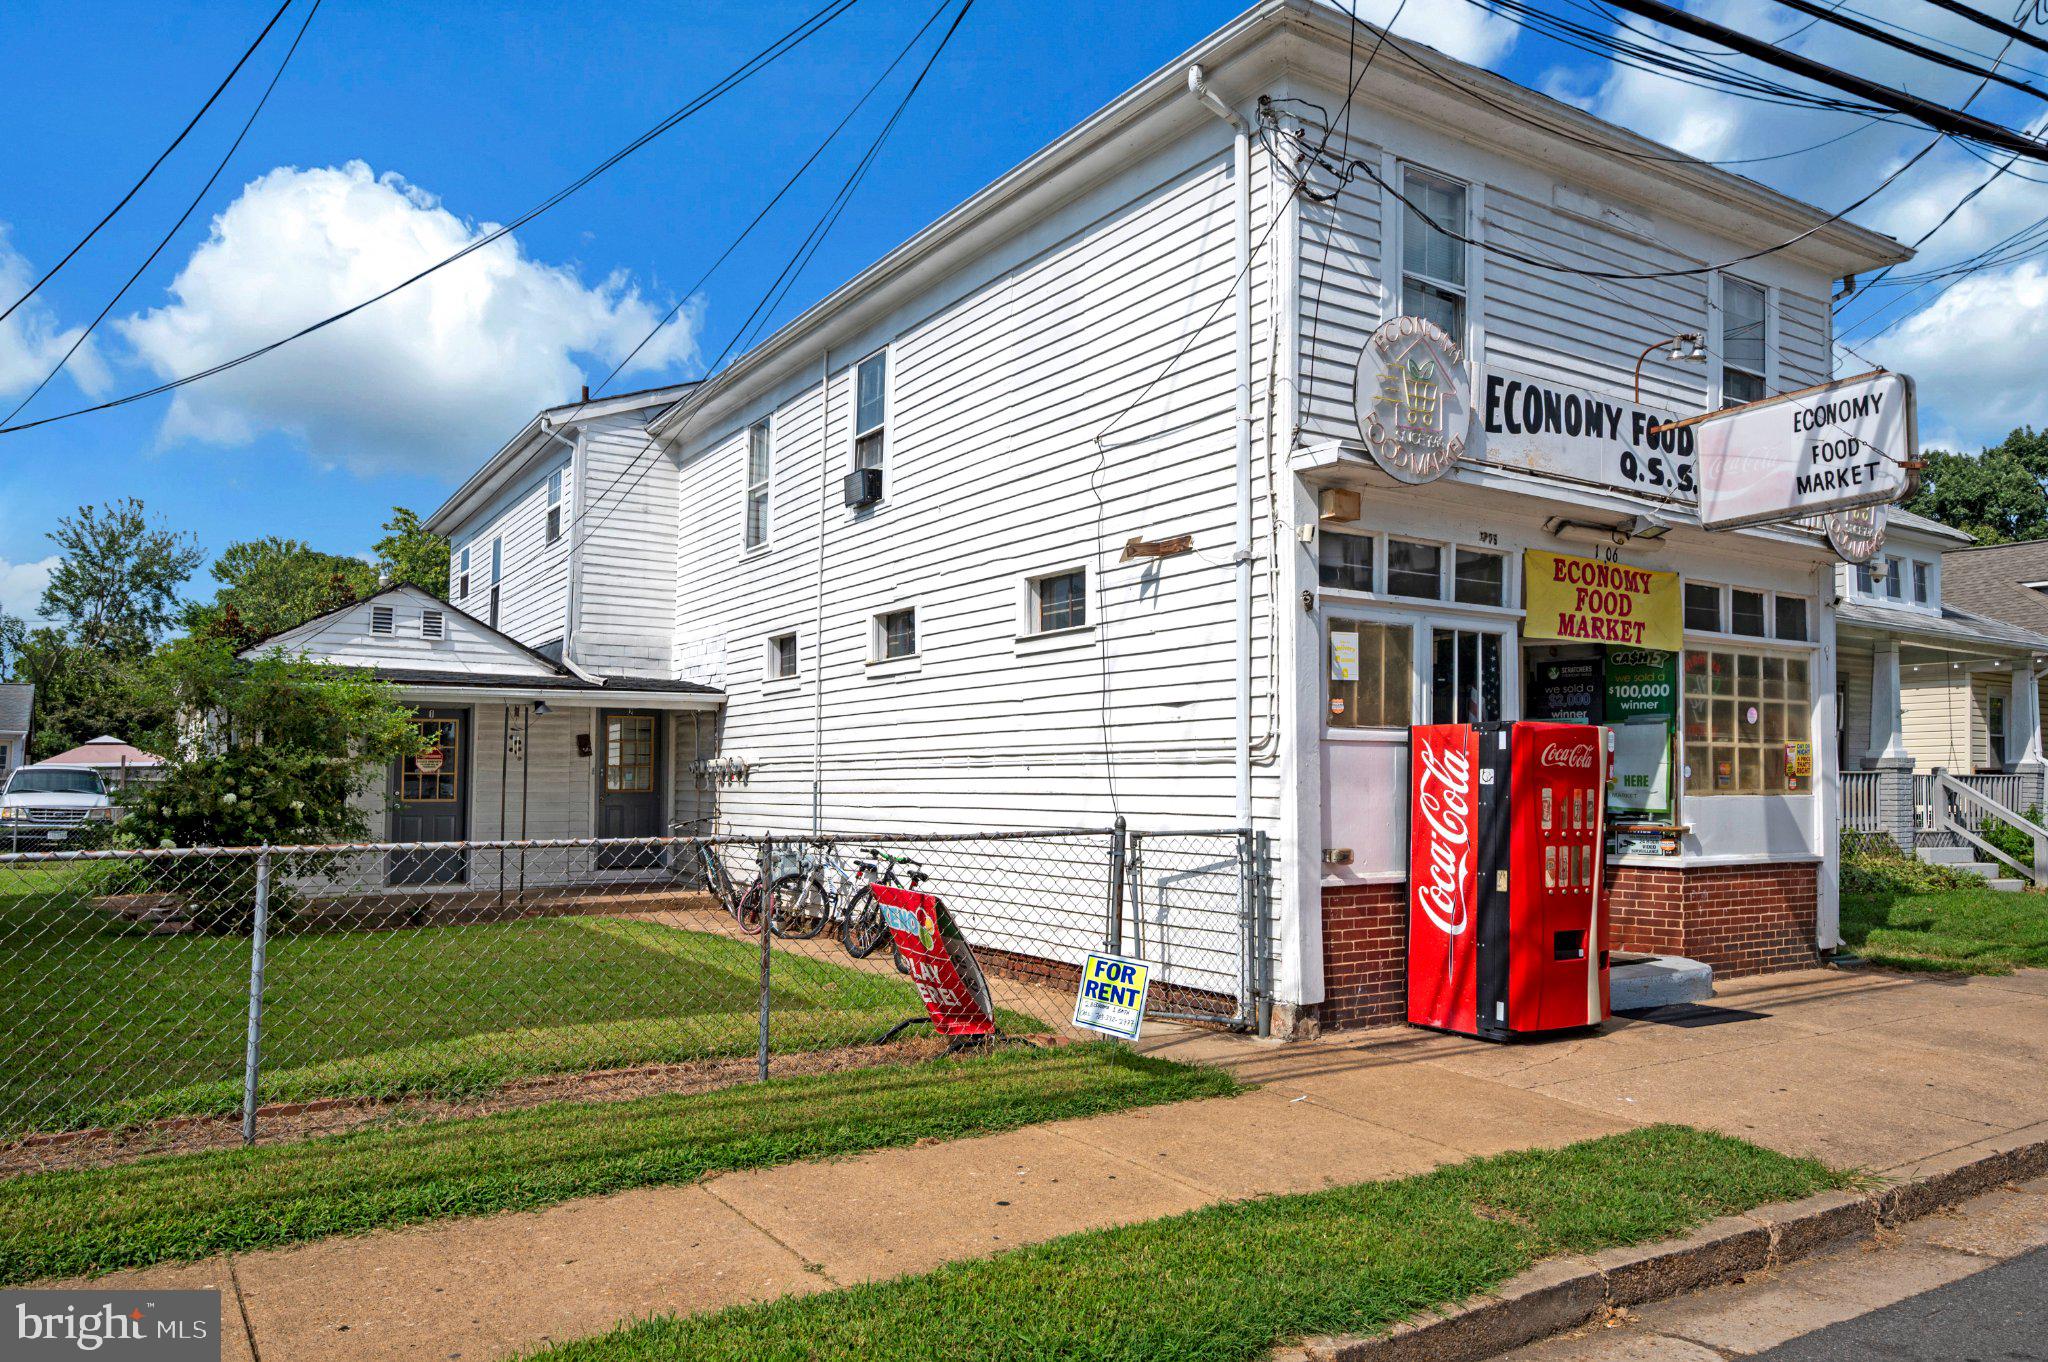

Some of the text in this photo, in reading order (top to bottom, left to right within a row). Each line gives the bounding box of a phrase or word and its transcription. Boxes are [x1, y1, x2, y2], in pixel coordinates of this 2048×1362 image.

[1373, 315, 1463, 365] ECONOMY
[1485, 374, 1694, 457] ECONOMY FOOD
[1794, 392, 1883, 433] ECONOMY
[1361, 411, 1465, 475] FOOD MARKET
[1812, 437, 1860, 464] FOOD
[1620, 450, 1698, 495] Q.S.S.
[1796, 461, 1880, 495] MARKET
[1553, 558, 1653, 594] ECONOMY
[1575, 587, 1632, 617] FOOD
[1557, 612, 1646, 645] MARKET
[1563, 684, 1584, 693] sold
[1586, 685, 1594, 693] a
[1634, 672, 1655, 682] sold
[1658, 674, 1665, 682] a
[1608, 684, 1670, 699] $100,000
[1621, 700, 1659, 710] winner
[1551, 709, 1587, 719] winner
[1541, 742, 1594, 768] Coca-Cola
[1624, 775, 1649, 787] HERE
[1419, 738, 1470, 935] Coca-Cola
[1095, 960, 1136, 985] FOR
[915, 983, 962, 1006] ERE!
[1085, 979, 1140, 1007] RENT
